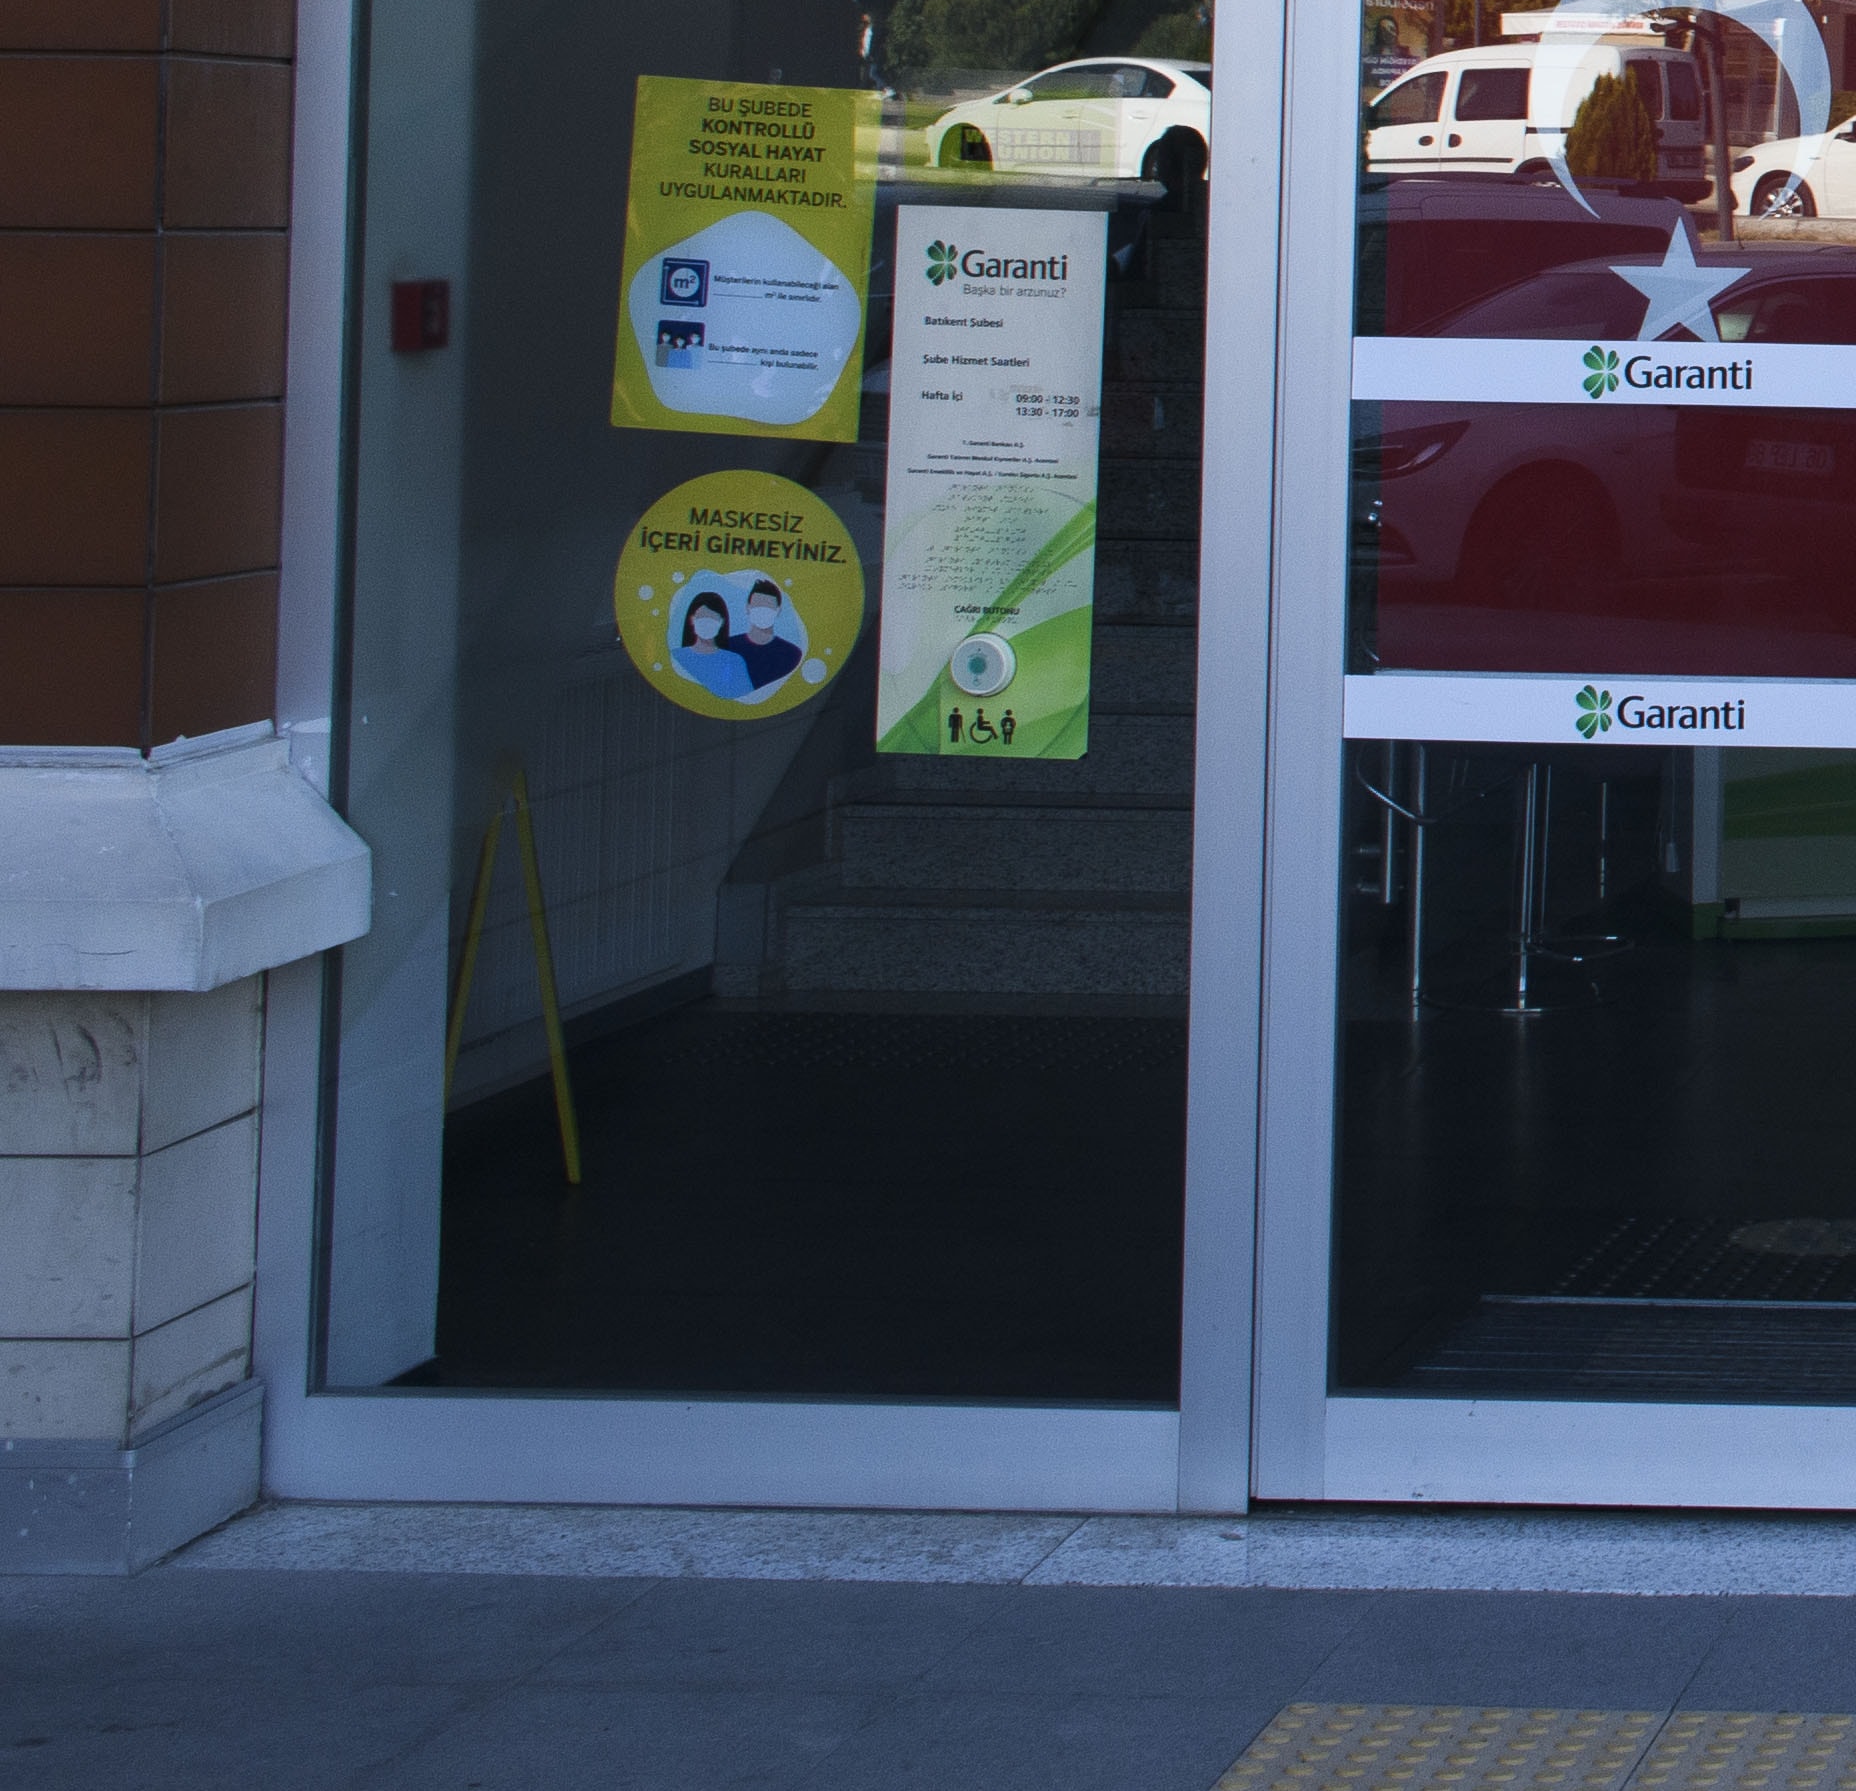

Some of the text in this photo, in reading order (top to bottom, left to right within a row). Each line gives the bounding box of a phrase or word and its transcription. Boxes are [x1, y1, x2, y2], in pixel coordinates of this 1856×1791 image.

[707, 96, 813, 118] BU ŞUBEDE
[701, 118, 816, 140] KONTROLLÜ
[688, 138, 827, 163] SOSYAL HAYAT
[703, 162, 807, 184] KURALLARI
[659, 180, 848, 209] UYGULANMAKTADIR.
[960, 249, 1069, 281] Garanti
[962, 283, 1068, 299] Başka bir arzunuz?
[924, 315, 1004, 329] Batıkent Şubesi
[922, 354, 1030, 368] Şube Hizmet Saatleri
[1623, 353, 1753, 392] Garanti
[921, 390, 949, 402] Hafta
[1015, 393, 1043, 404] 09:00
[1052, 394, 1081, 405] 12:30
[1015, 406, 1043, 417] 13:30
[1052, 408, 1080, 418] 17:00
[689, 507, 805, 535] MASKESİZ
[640, 526, 848, 565] İÇERİ GİRMEYİNİZ.
[983, 606, 1021, 616] BUTONU
[1616, 695, 1746, 733] Garanti
